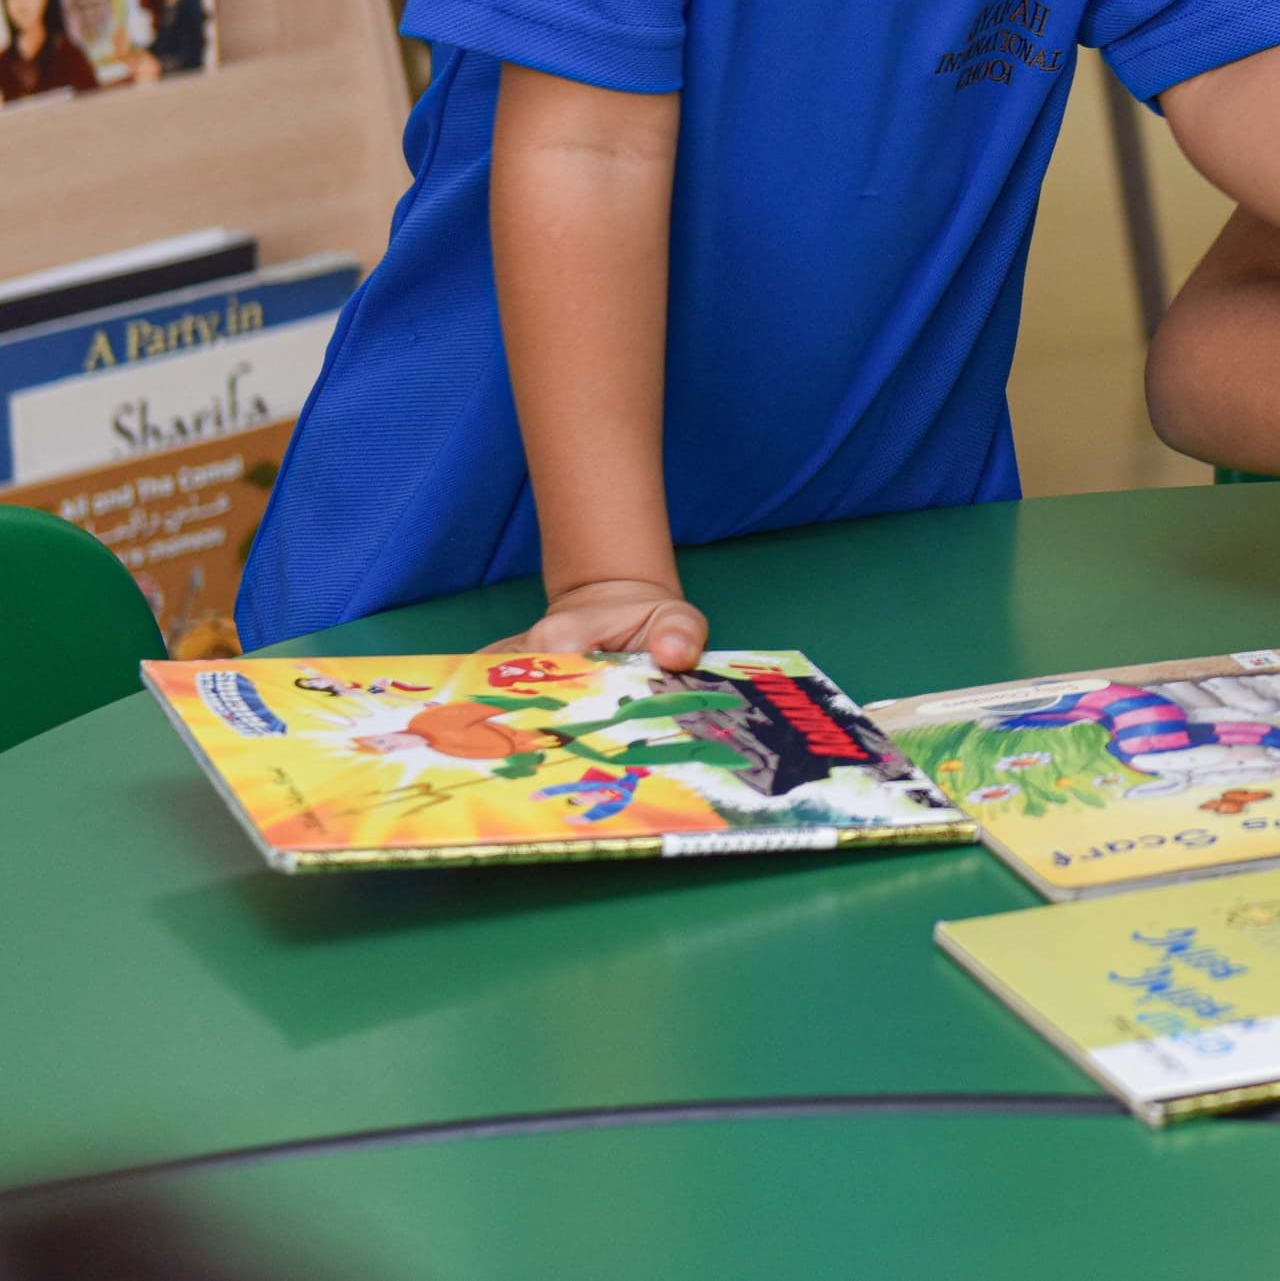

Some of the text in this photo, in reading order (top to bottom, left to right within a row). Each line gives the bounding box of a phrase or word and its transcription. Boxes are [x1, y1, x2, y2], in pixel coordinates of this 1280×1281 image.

[84, 294, 264, 373] A Party in
[1051, 827, 1219, 869] Scarf
